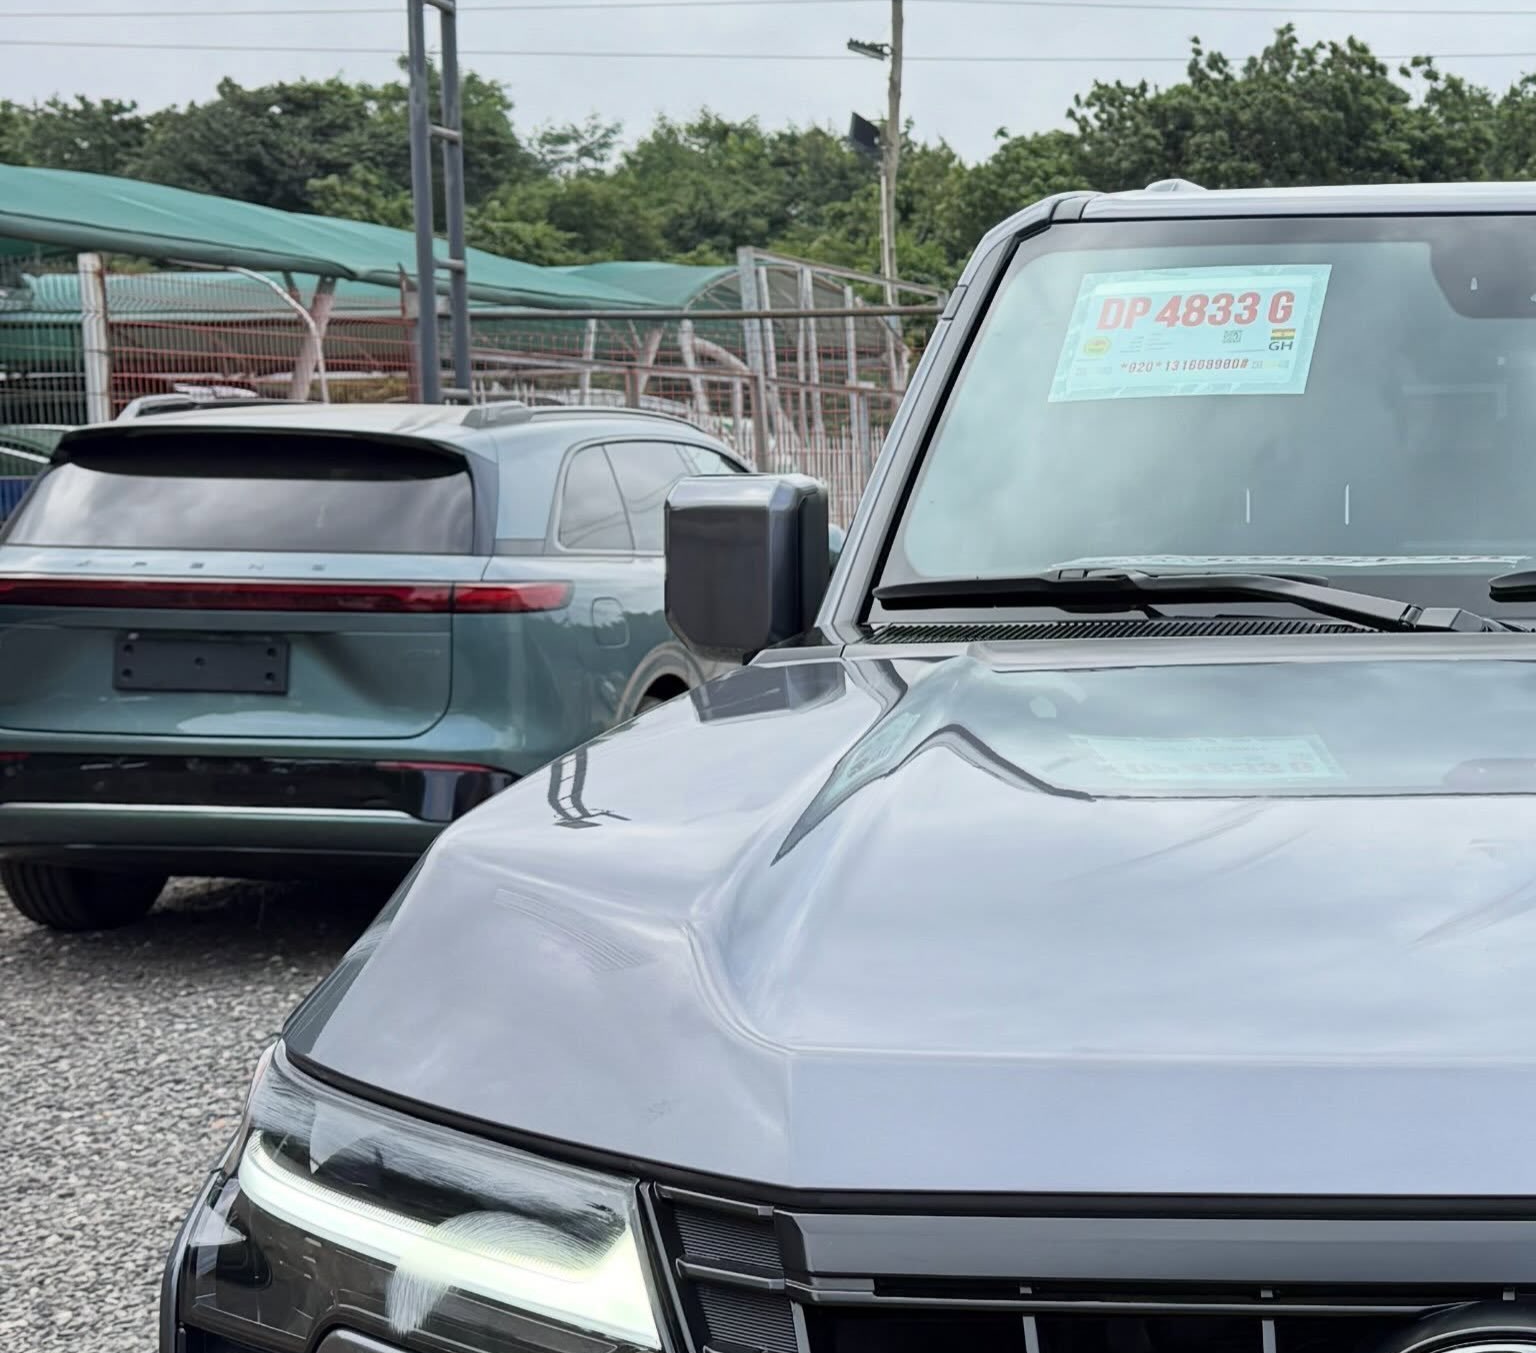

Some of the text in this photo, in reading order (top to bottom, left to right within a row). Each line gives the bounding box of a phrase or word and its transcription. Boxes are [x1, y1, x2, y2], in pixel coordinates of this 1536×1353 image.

[1097, 290, 1297, 330] DP 4833 G
[1268, 341, 1294, 351] GH
